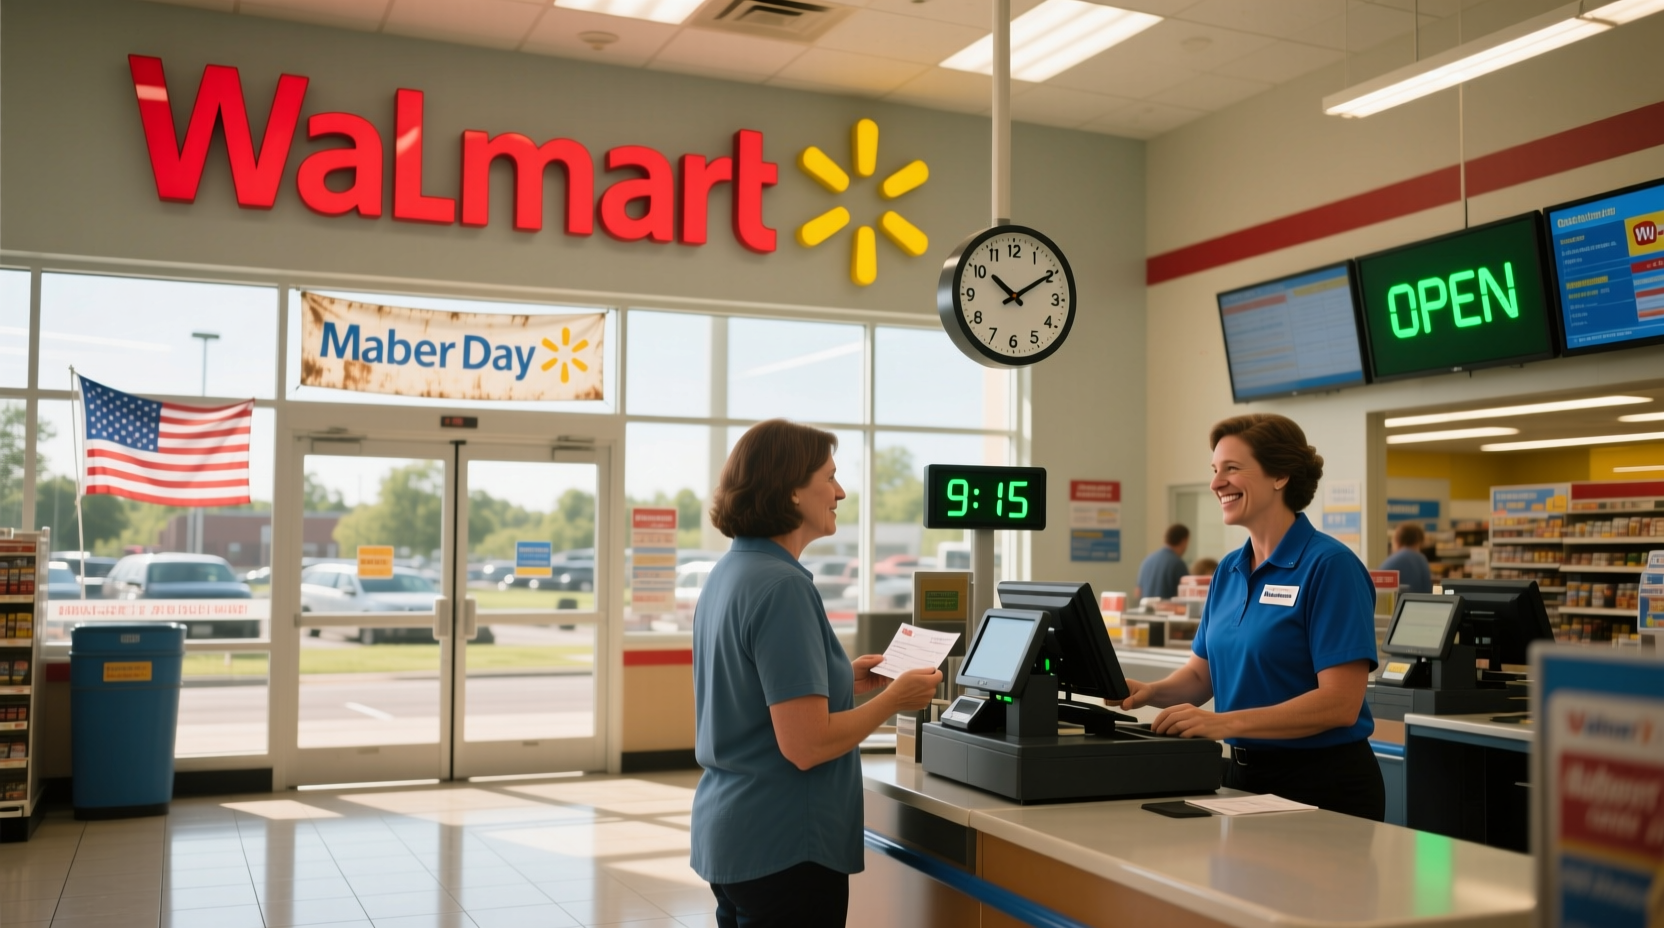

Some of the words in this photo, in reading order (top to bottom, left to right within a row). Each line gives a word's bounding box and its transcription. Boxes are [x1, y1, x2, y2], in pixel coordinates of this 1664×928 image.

[989, 248, 999, 262] 11
[1008, 244, 1021, 258] 12
[974, 264, 987, 279] 10
[1045, 270, 1054, 283] 2
[966, 288, 975, 301] 9
[1051, 293, 1060, 306] 3
[1388, 261, 1519, 338] OPEN
[973, 311, 982, 324] 8
[1043, 315, 1052, 328] 4
[988, 327, 998, 344] 7
[1008, 335, 1018, 348] 6
[1029, 330, 1039, 344] 5
[319, 321, 456, 369] Maber
[462, 335, 536, 382] Day
[947, 478, 1028, 518] 9:15
